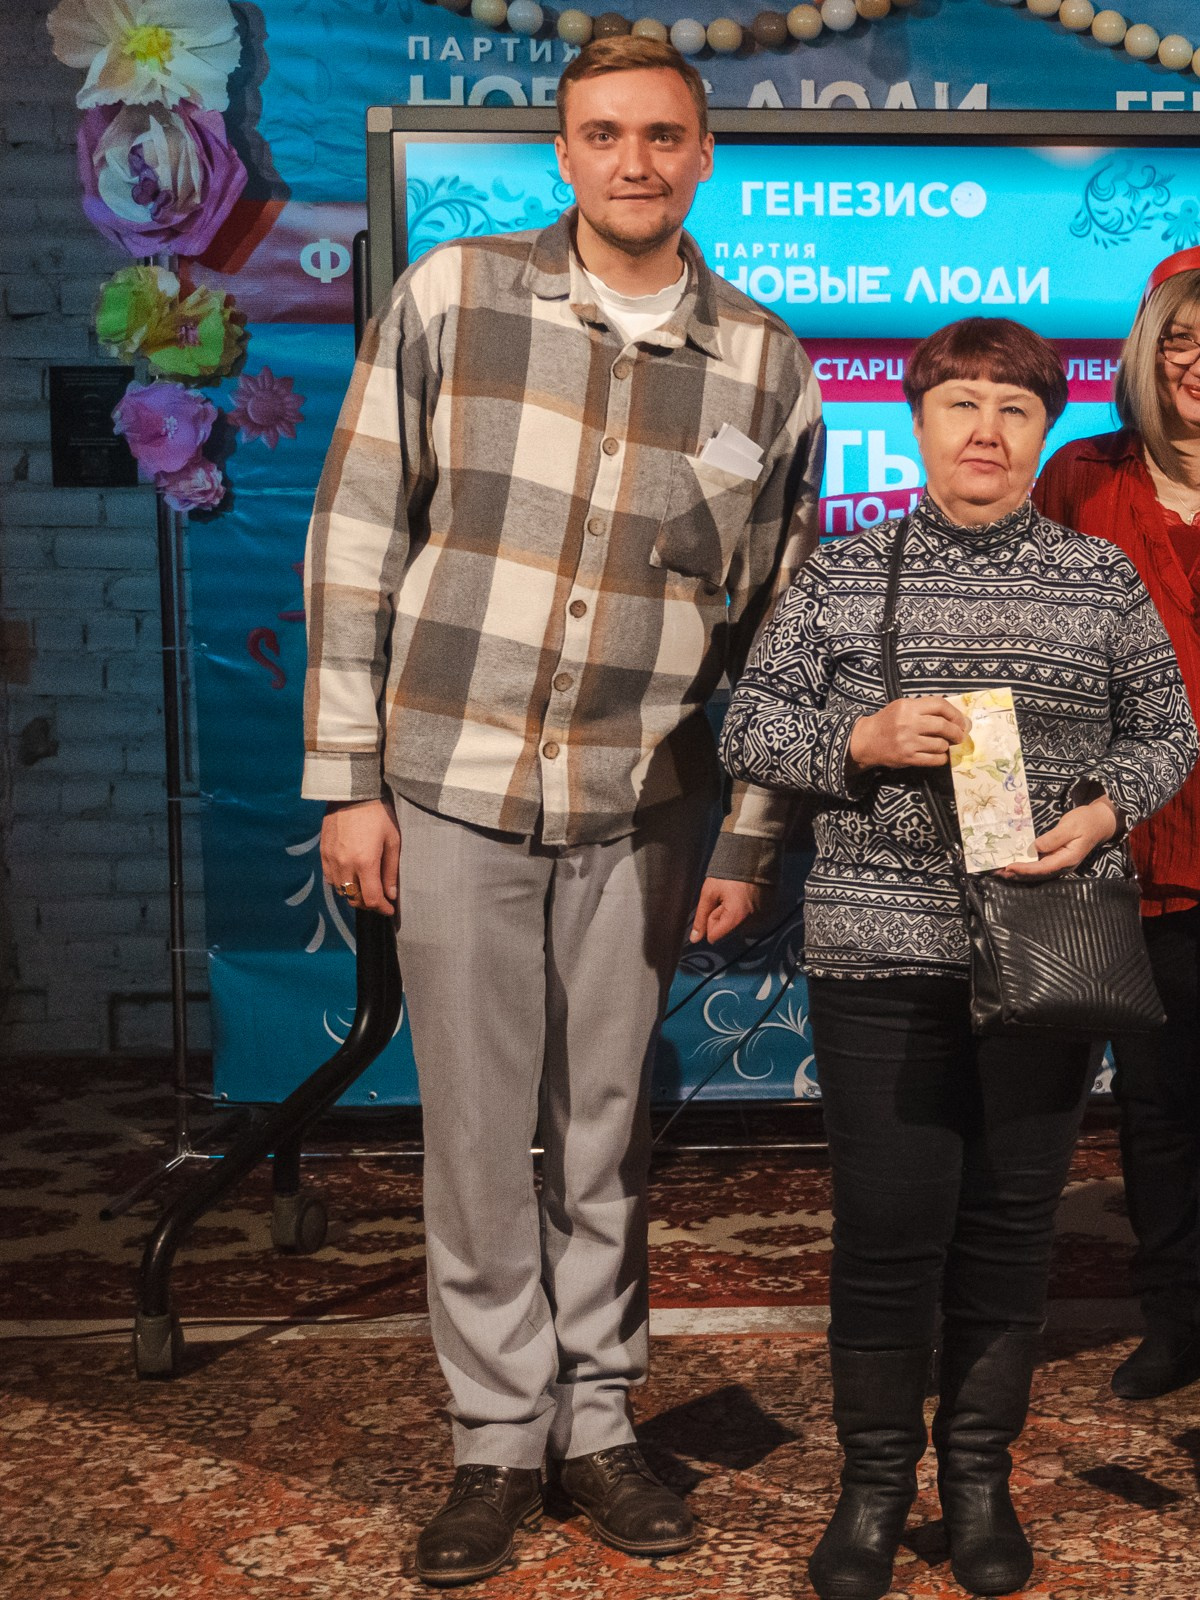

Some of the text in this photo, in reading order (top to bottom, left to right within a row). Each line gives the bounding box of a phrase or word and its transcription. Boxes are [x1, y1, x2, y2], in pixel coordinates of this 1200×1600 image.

[714, 242, 815, 259] ПАРТИЯ
[715, 264, 1050, 305] НОВЫЕ ЛЮДИ
